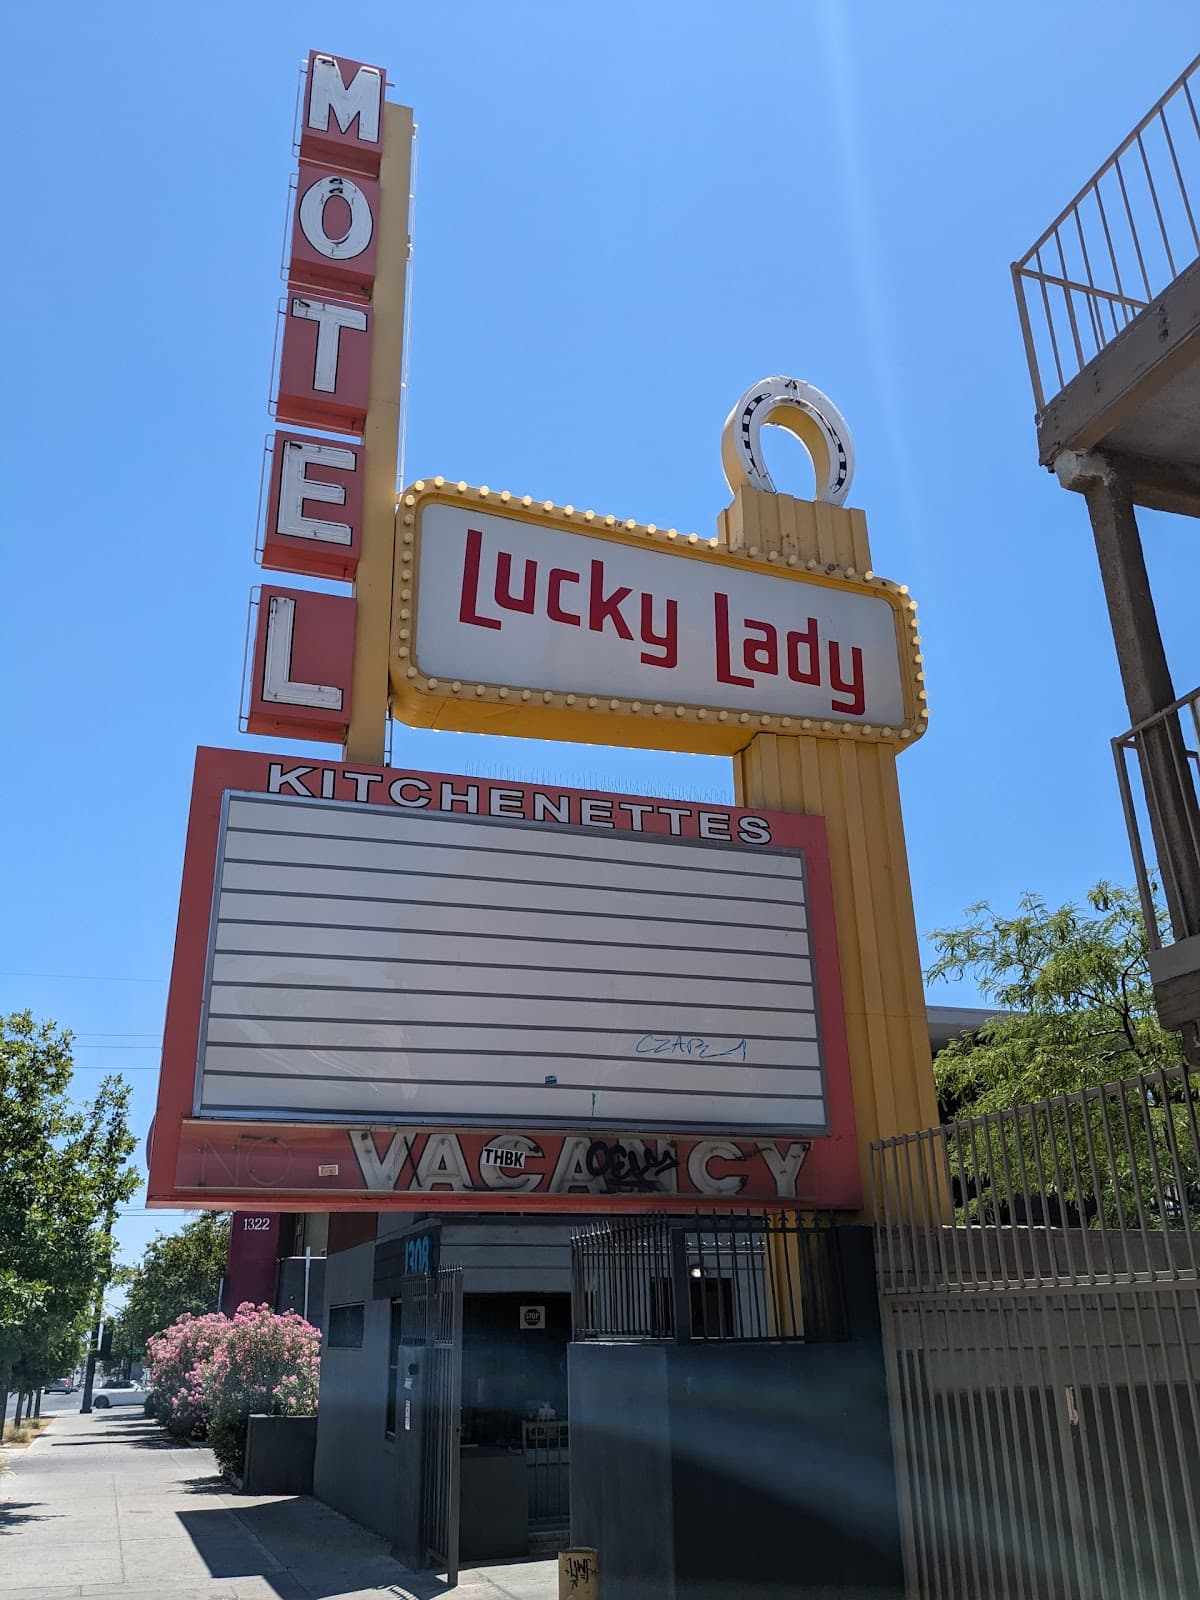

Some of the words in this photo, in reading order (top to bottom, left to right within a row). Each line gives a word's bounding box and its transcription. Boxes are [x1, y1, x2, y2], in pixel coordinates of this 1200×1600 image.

[263, 55, 382, 711] MOTEL
[459, 529, 678, 668] Lucky
[714, 592, 866, 715] Lady
[267, 762, 773, 845] KITCHENETTES
[347, 1129, 810, 1198] VACANCY
[484, 1148, 524, 1168] THBK
[243, 1217, 270, 1231] 1322
